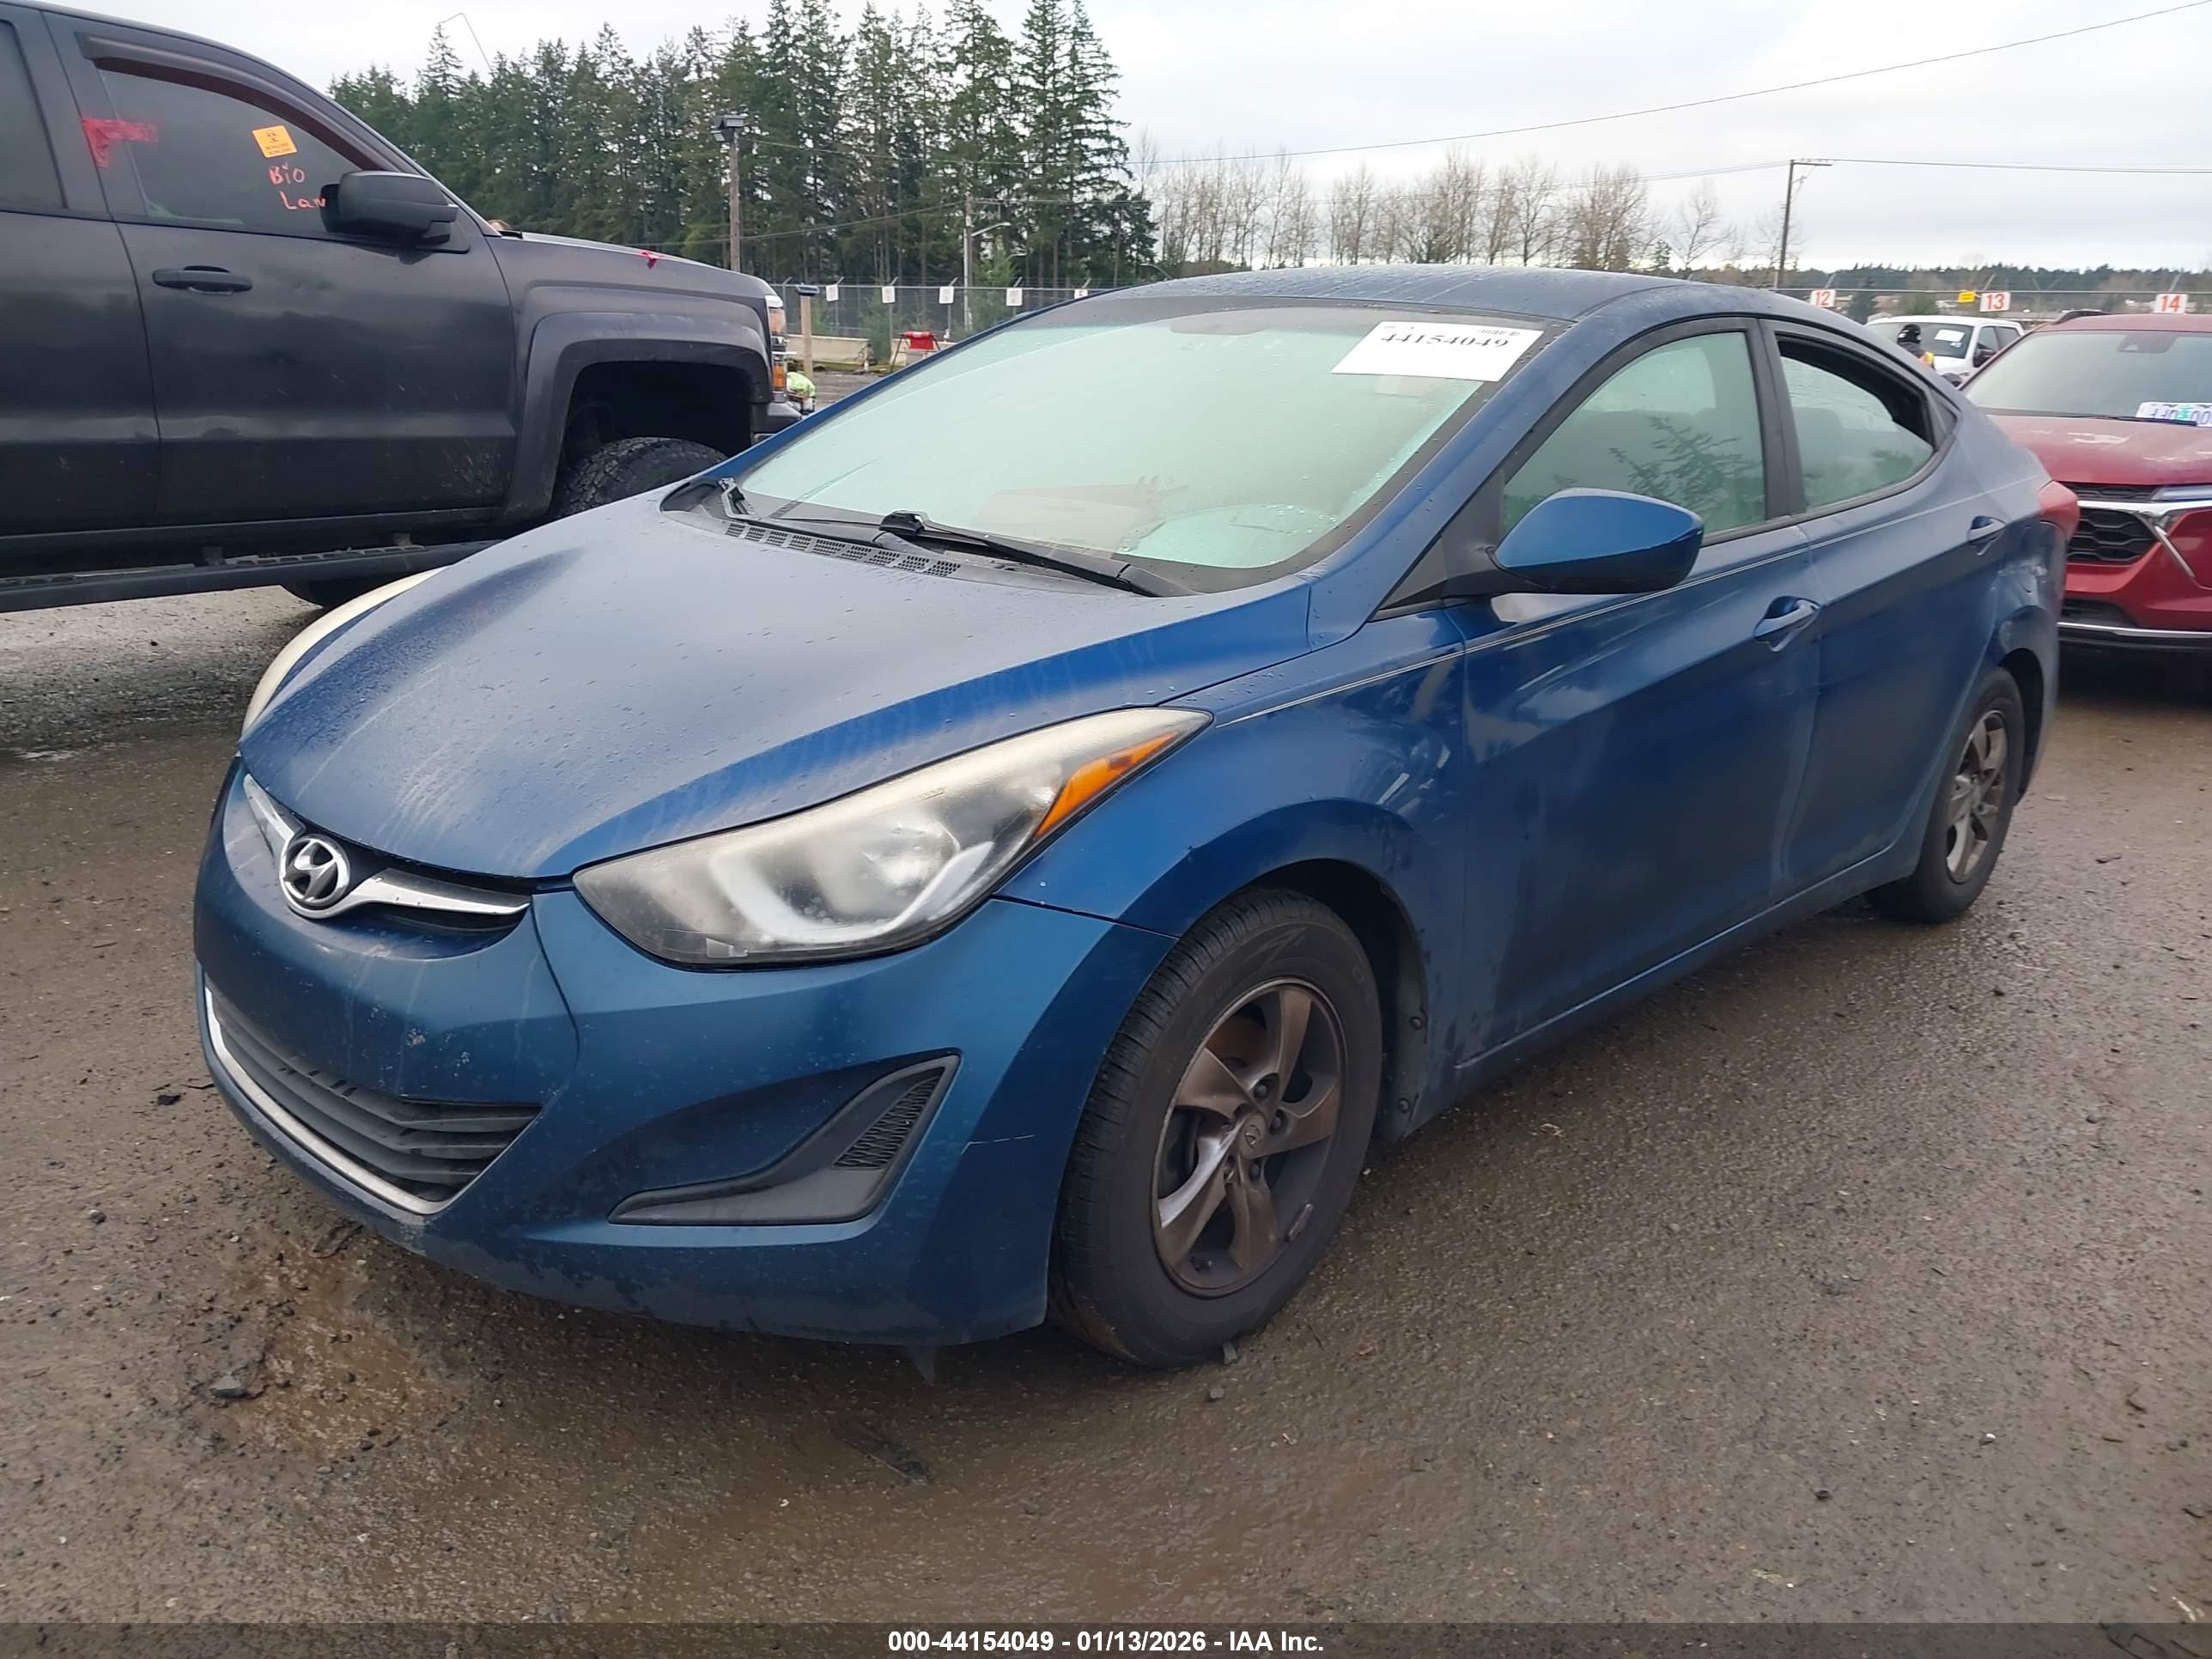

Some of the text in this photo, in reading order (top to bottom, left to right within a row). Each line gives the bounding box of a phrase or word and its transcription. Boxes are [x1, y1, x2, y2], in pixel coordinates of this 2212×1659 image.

[1814, 291, 1831, 307] 12
[1987, 293, 2005, 310] 13
[2160, 295, 2179, 312] 14
[1381, 332, 1510, 348] 44154049
